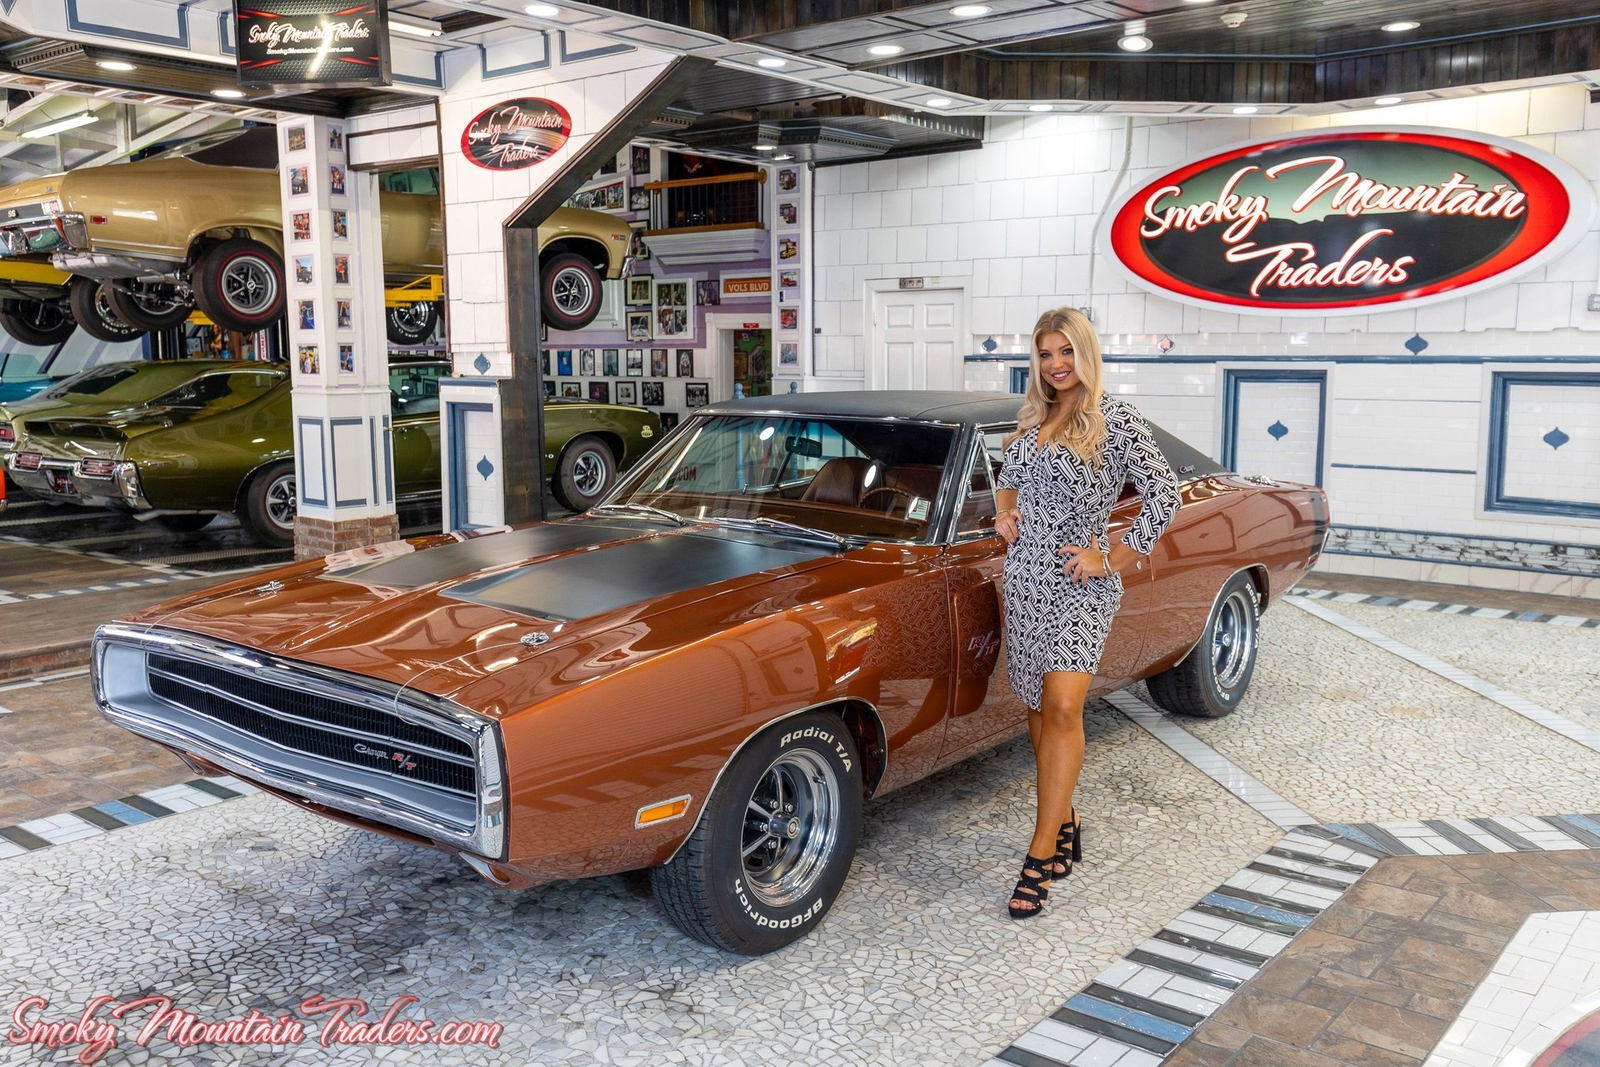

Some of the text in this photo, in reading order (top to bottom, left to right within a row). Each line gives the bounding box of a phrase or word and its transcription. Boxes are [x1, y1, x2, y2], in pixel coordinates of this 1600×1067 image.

[249, 21, 281, 48] Smoky
[275, 22, 331, 44] Mountai
[468, 105, 563, 145] Smoky Mountain
[489, 135, 540, 168] Traders
[1141, 156, 1529, 243] Smoky Mountain
[1226, 228, 1416, 297] Traders
[728, 282, 769, 292] VOLS BLVD
[967, 630, 1000, 660] R/T
[354, 743, 417, 771] Charger R/T
[780, 726, 853, 773] Radial T/A
[735, 878, 823, 929] BFGoodrich
